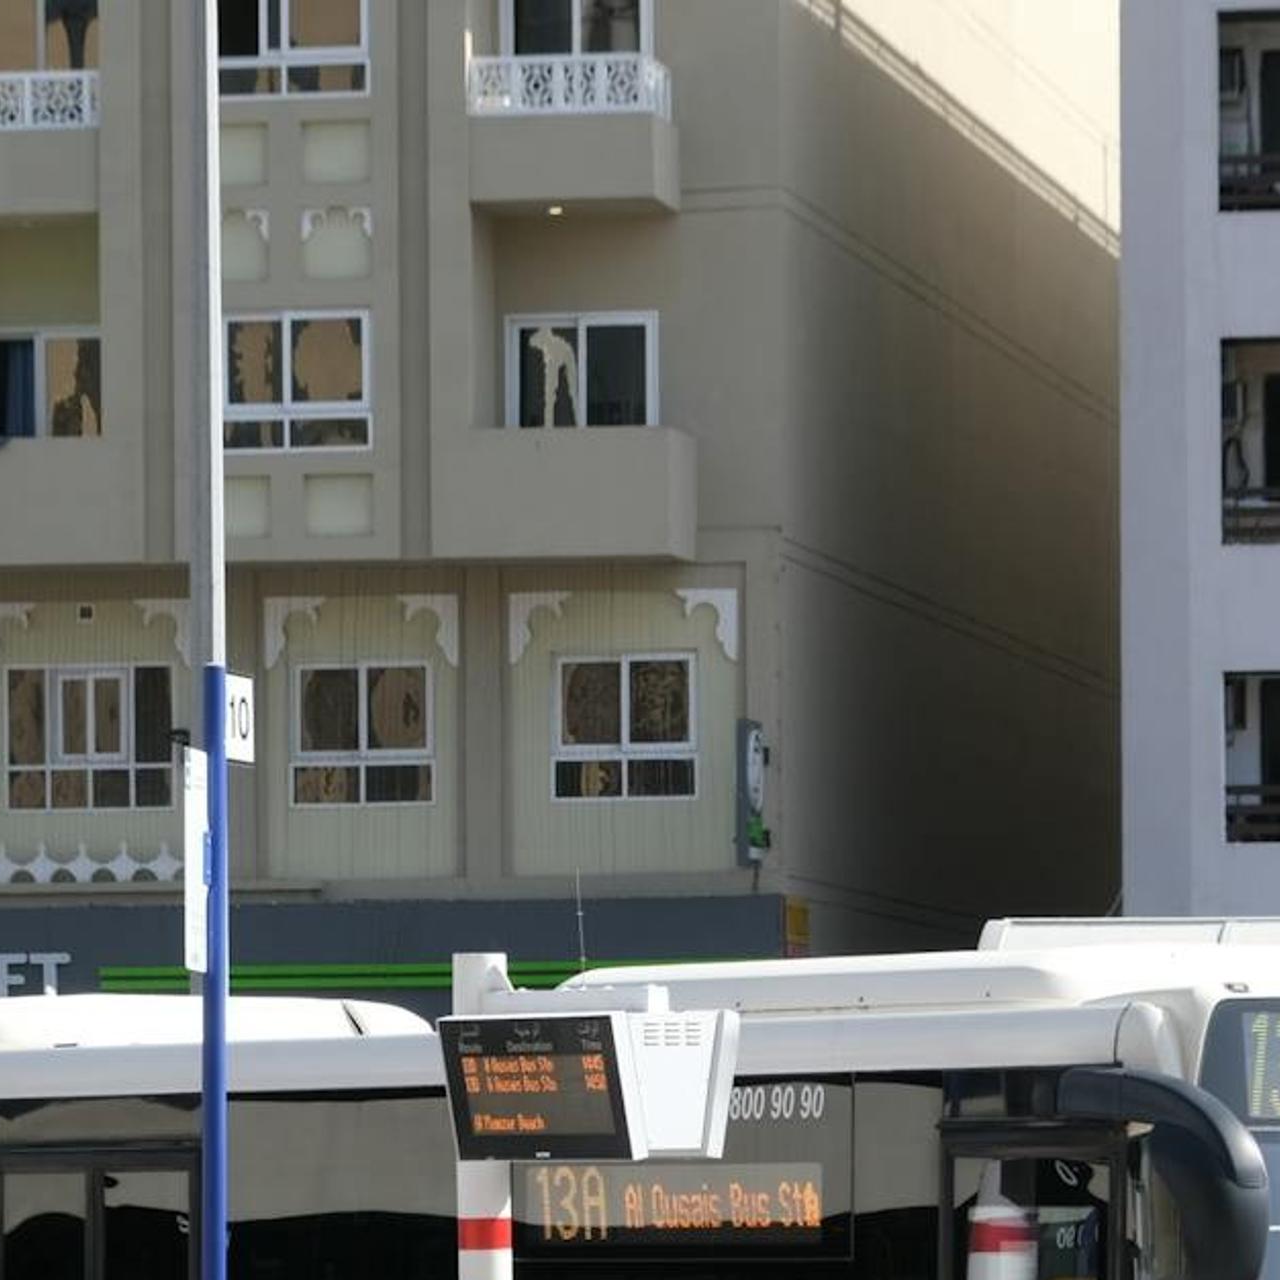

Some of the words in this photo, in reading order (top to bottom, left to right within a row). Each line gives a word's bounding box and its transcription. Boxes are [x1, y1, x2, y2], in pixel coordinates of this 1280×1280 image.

[228, 695, 251, 741] 10
[730, 1086, 765, 1119] 800
[771, 1086, 795, 1118] 90
[801, 1085, 824, 1118] 90
[536, 1166, 607, 1240] 13A
[624, 1183, 644, 1228] Al
[729, 1182, 770, 1228] Bus
